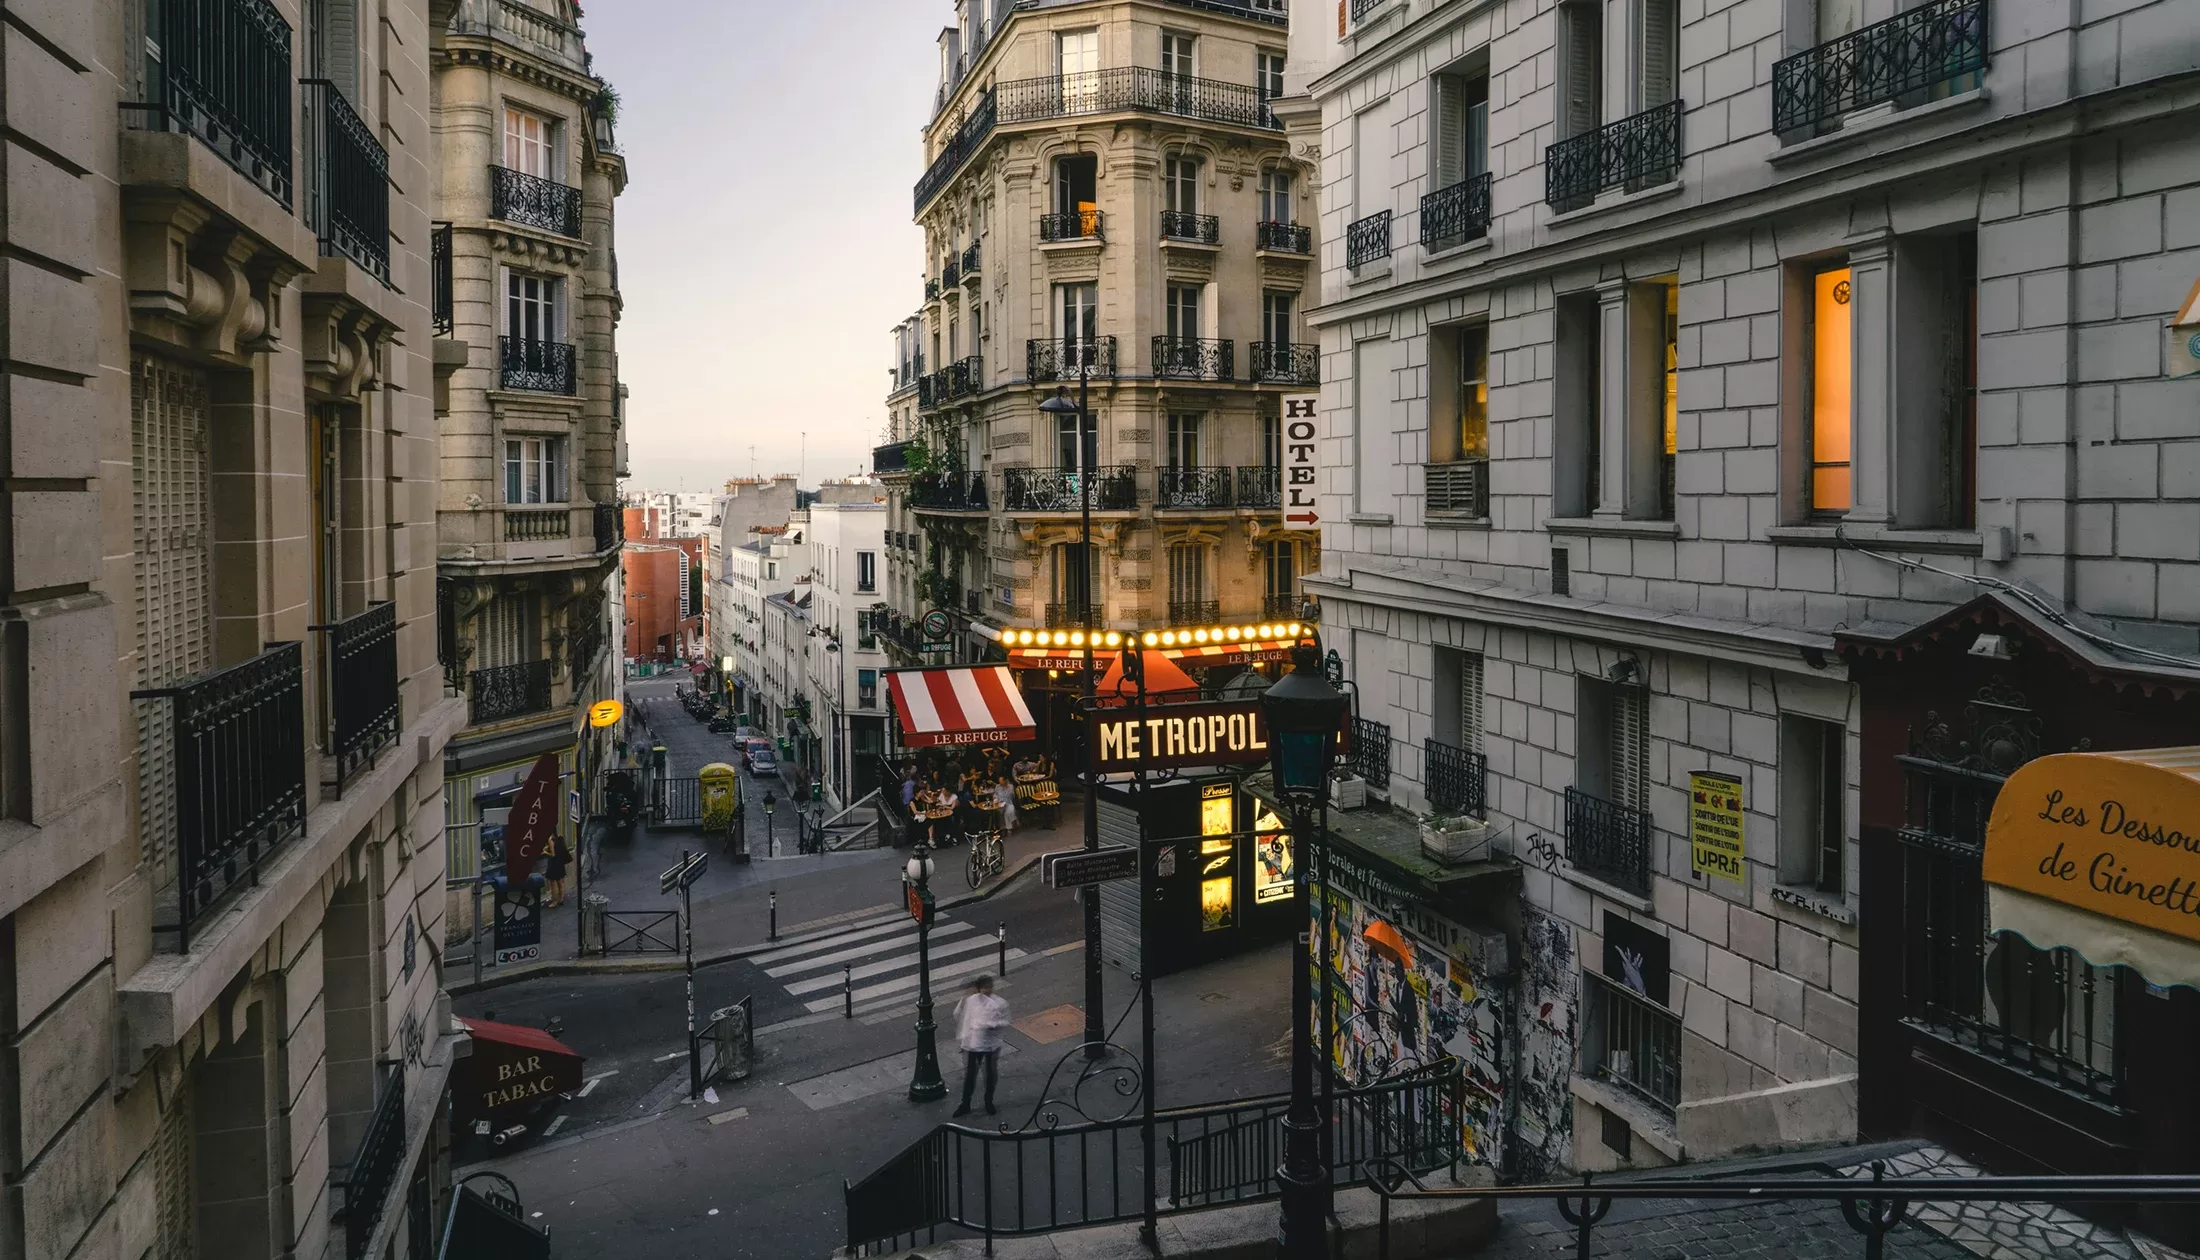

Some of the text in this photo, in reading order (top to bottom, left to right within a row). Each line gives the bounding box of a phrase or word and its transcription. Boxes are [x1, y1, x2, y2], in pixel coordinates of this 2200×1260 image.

[1286, 399, 1317, 507] HOTEL
[1037, 659, 1054, 669] LE
[1228, 654, 1242, 664] LE
[933, 730, 1008, 745] LE REFUGE
[519, 780, 549, 857] TABAC
[1695, 808, 1716, 821] SORTIR
[1716, 814, 1725, 824] DE
[2038, 789, 2200, 854] Les Dessou
[1695, 822, 1713, 833] SORTIR
[1695, 834, 1714, 845] SORTIR
[2038, 842, 2078, 881] de
[499, 948, 538, 963] LOTO
[498, 1055, 542, 1081] BAR
[482, 1075, 555, 1108] TABAC
